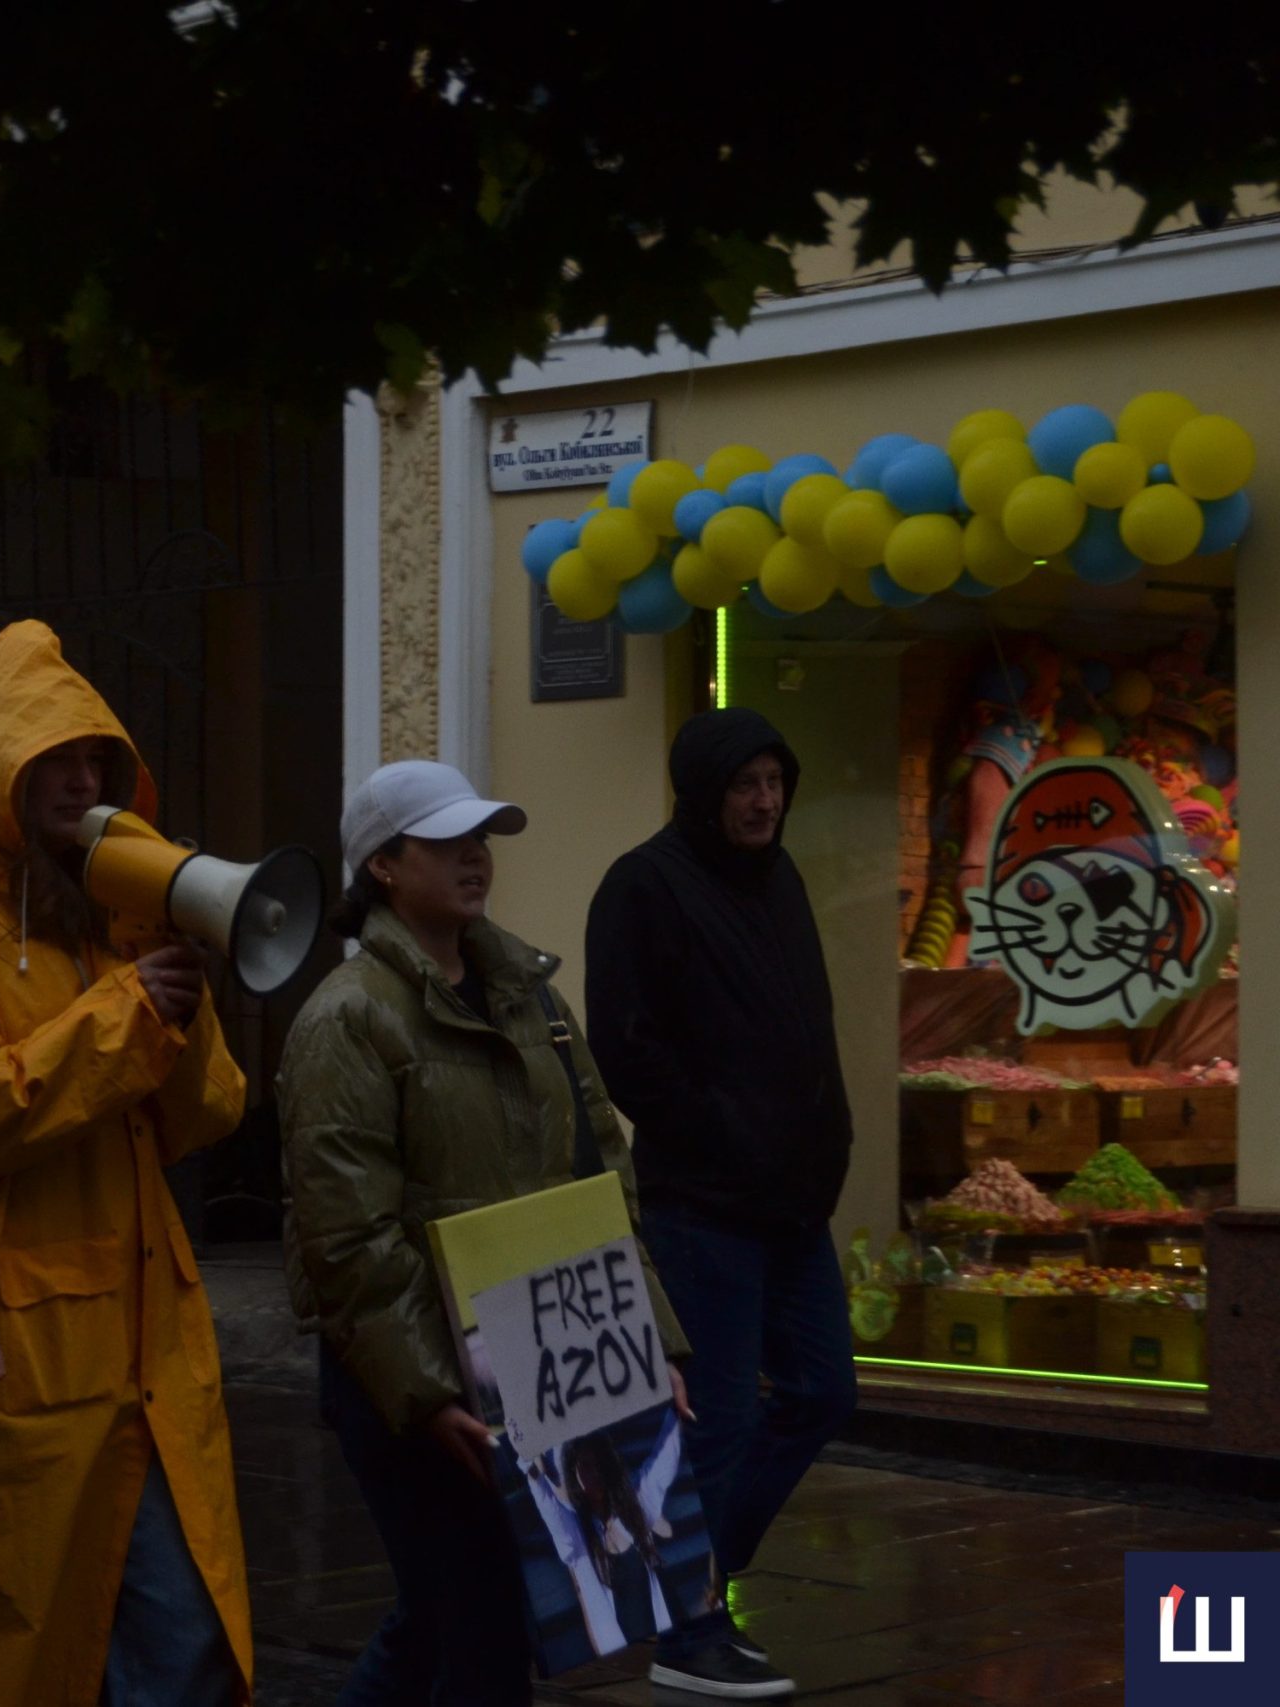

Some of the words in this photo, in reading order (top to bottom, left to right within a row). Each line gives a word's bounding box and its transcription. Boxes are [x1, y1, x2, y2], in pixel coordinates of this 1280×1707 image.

[582, 407, 615, 438] 22
[530, 1250, 635, 1348] FREE
[536, 1323, 657, 1423] AZOV
